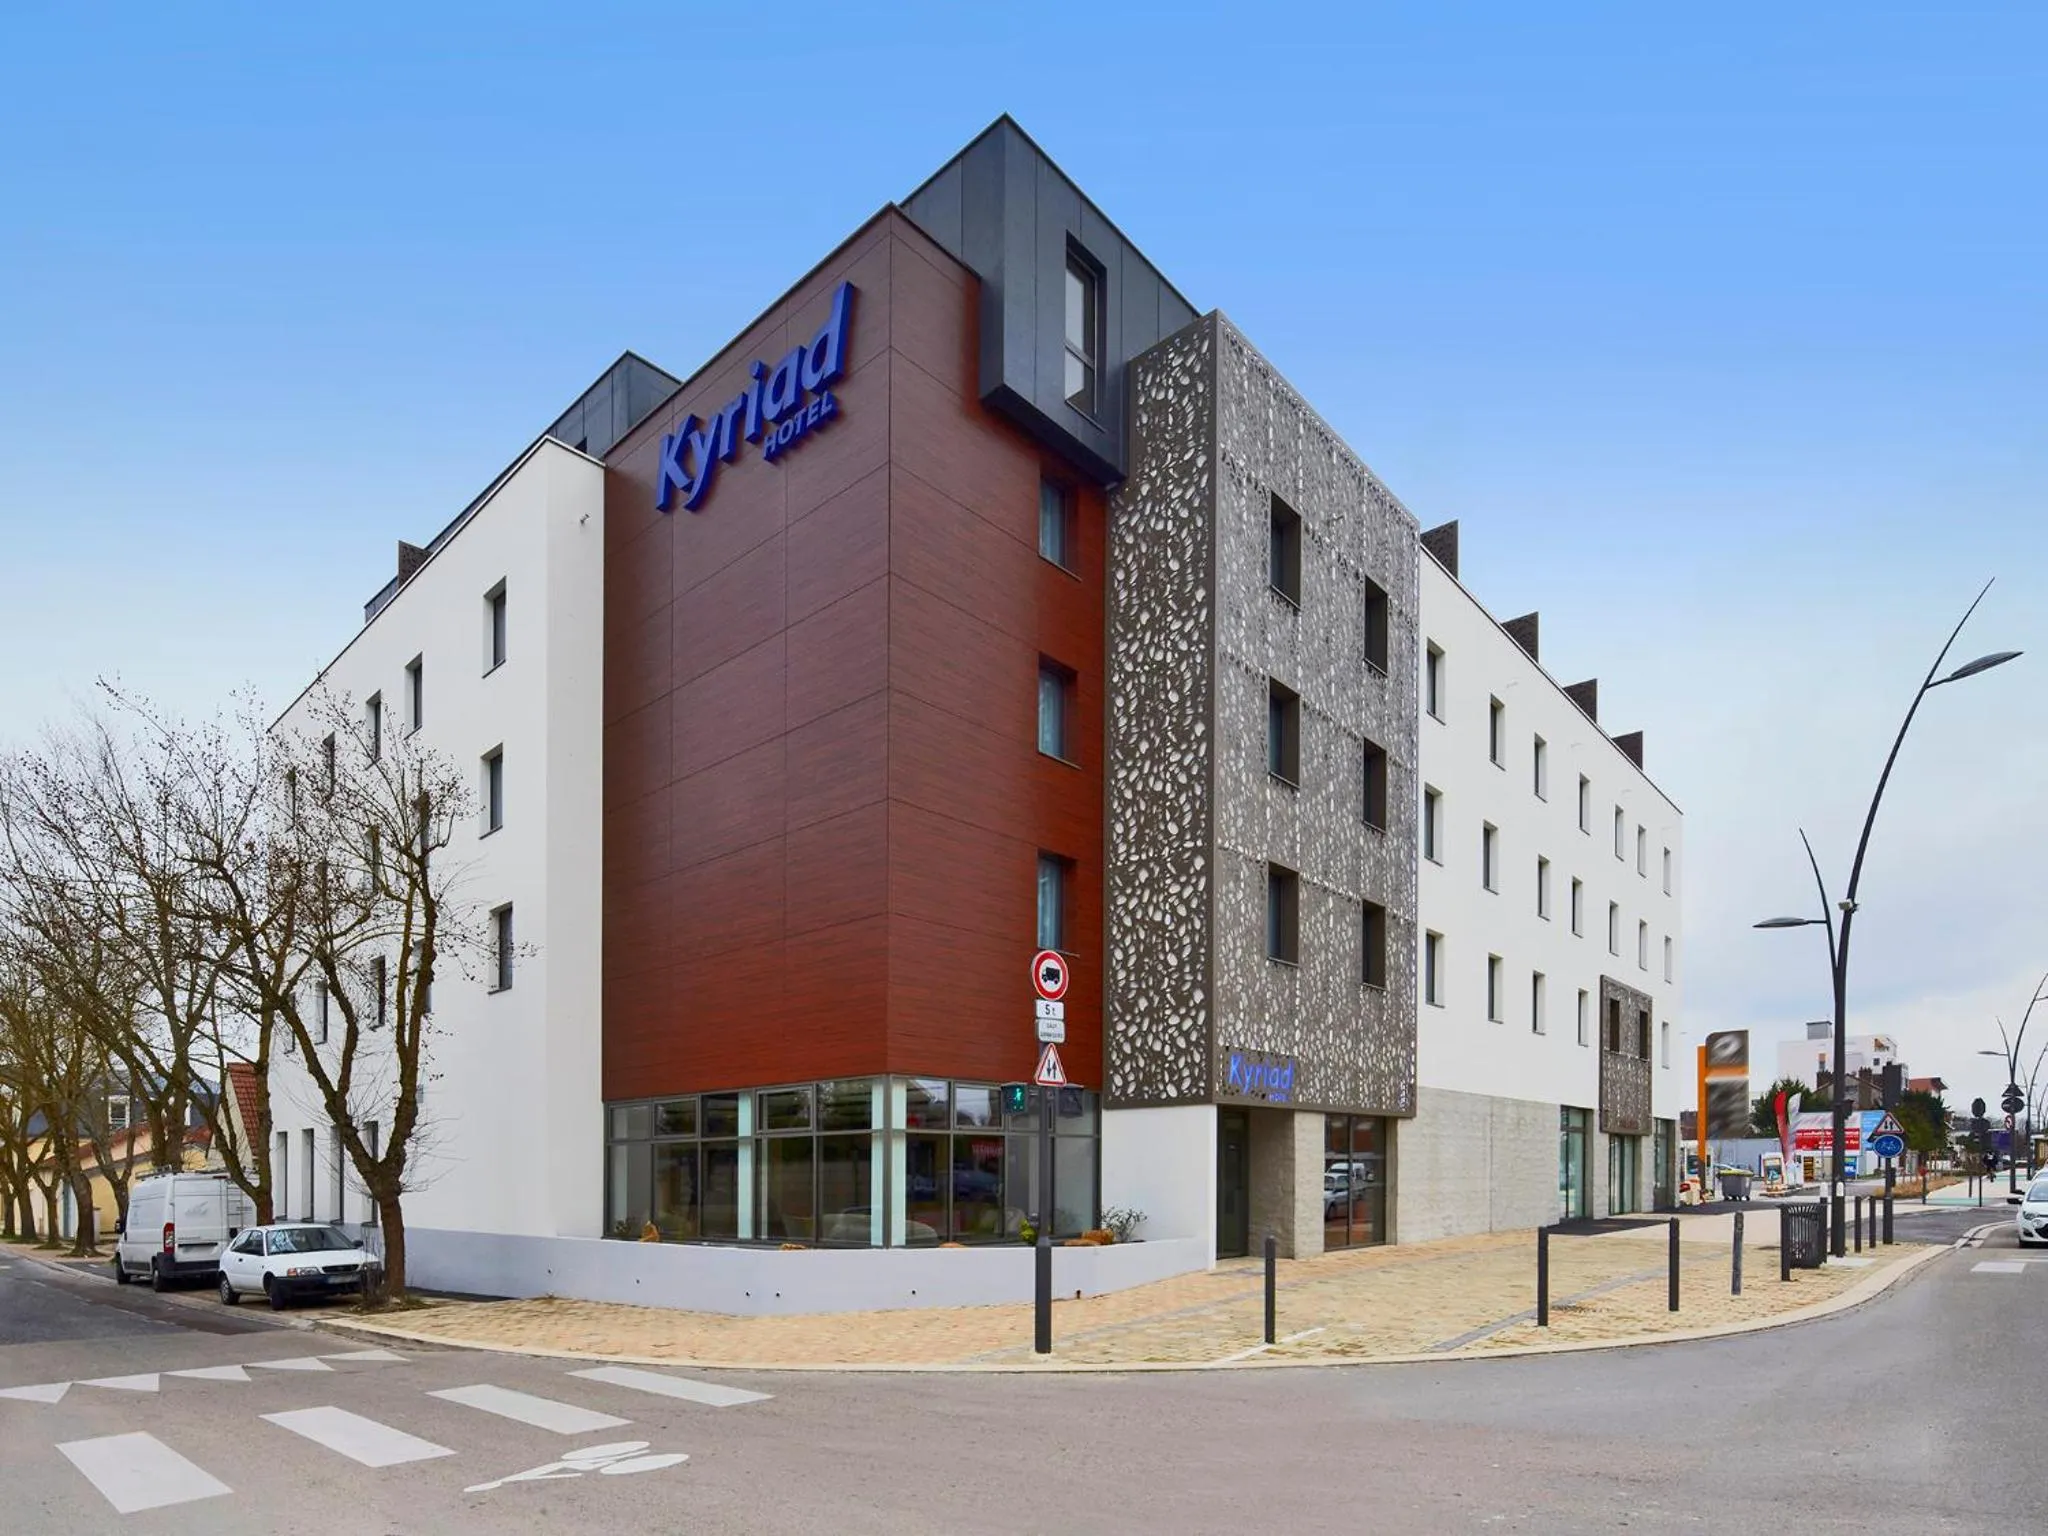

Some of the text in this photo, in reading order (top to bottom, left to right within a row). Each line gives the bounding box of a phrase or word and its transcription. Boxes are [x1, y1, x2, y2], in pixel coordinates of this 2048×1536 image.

[656, 281, 855, 513] Kyriad
[763, 391, 838, 462] HOTEL
[1045, 1004, 1051, 1015] 5
[1228, 1053, 1294, 1095] Kyriad
